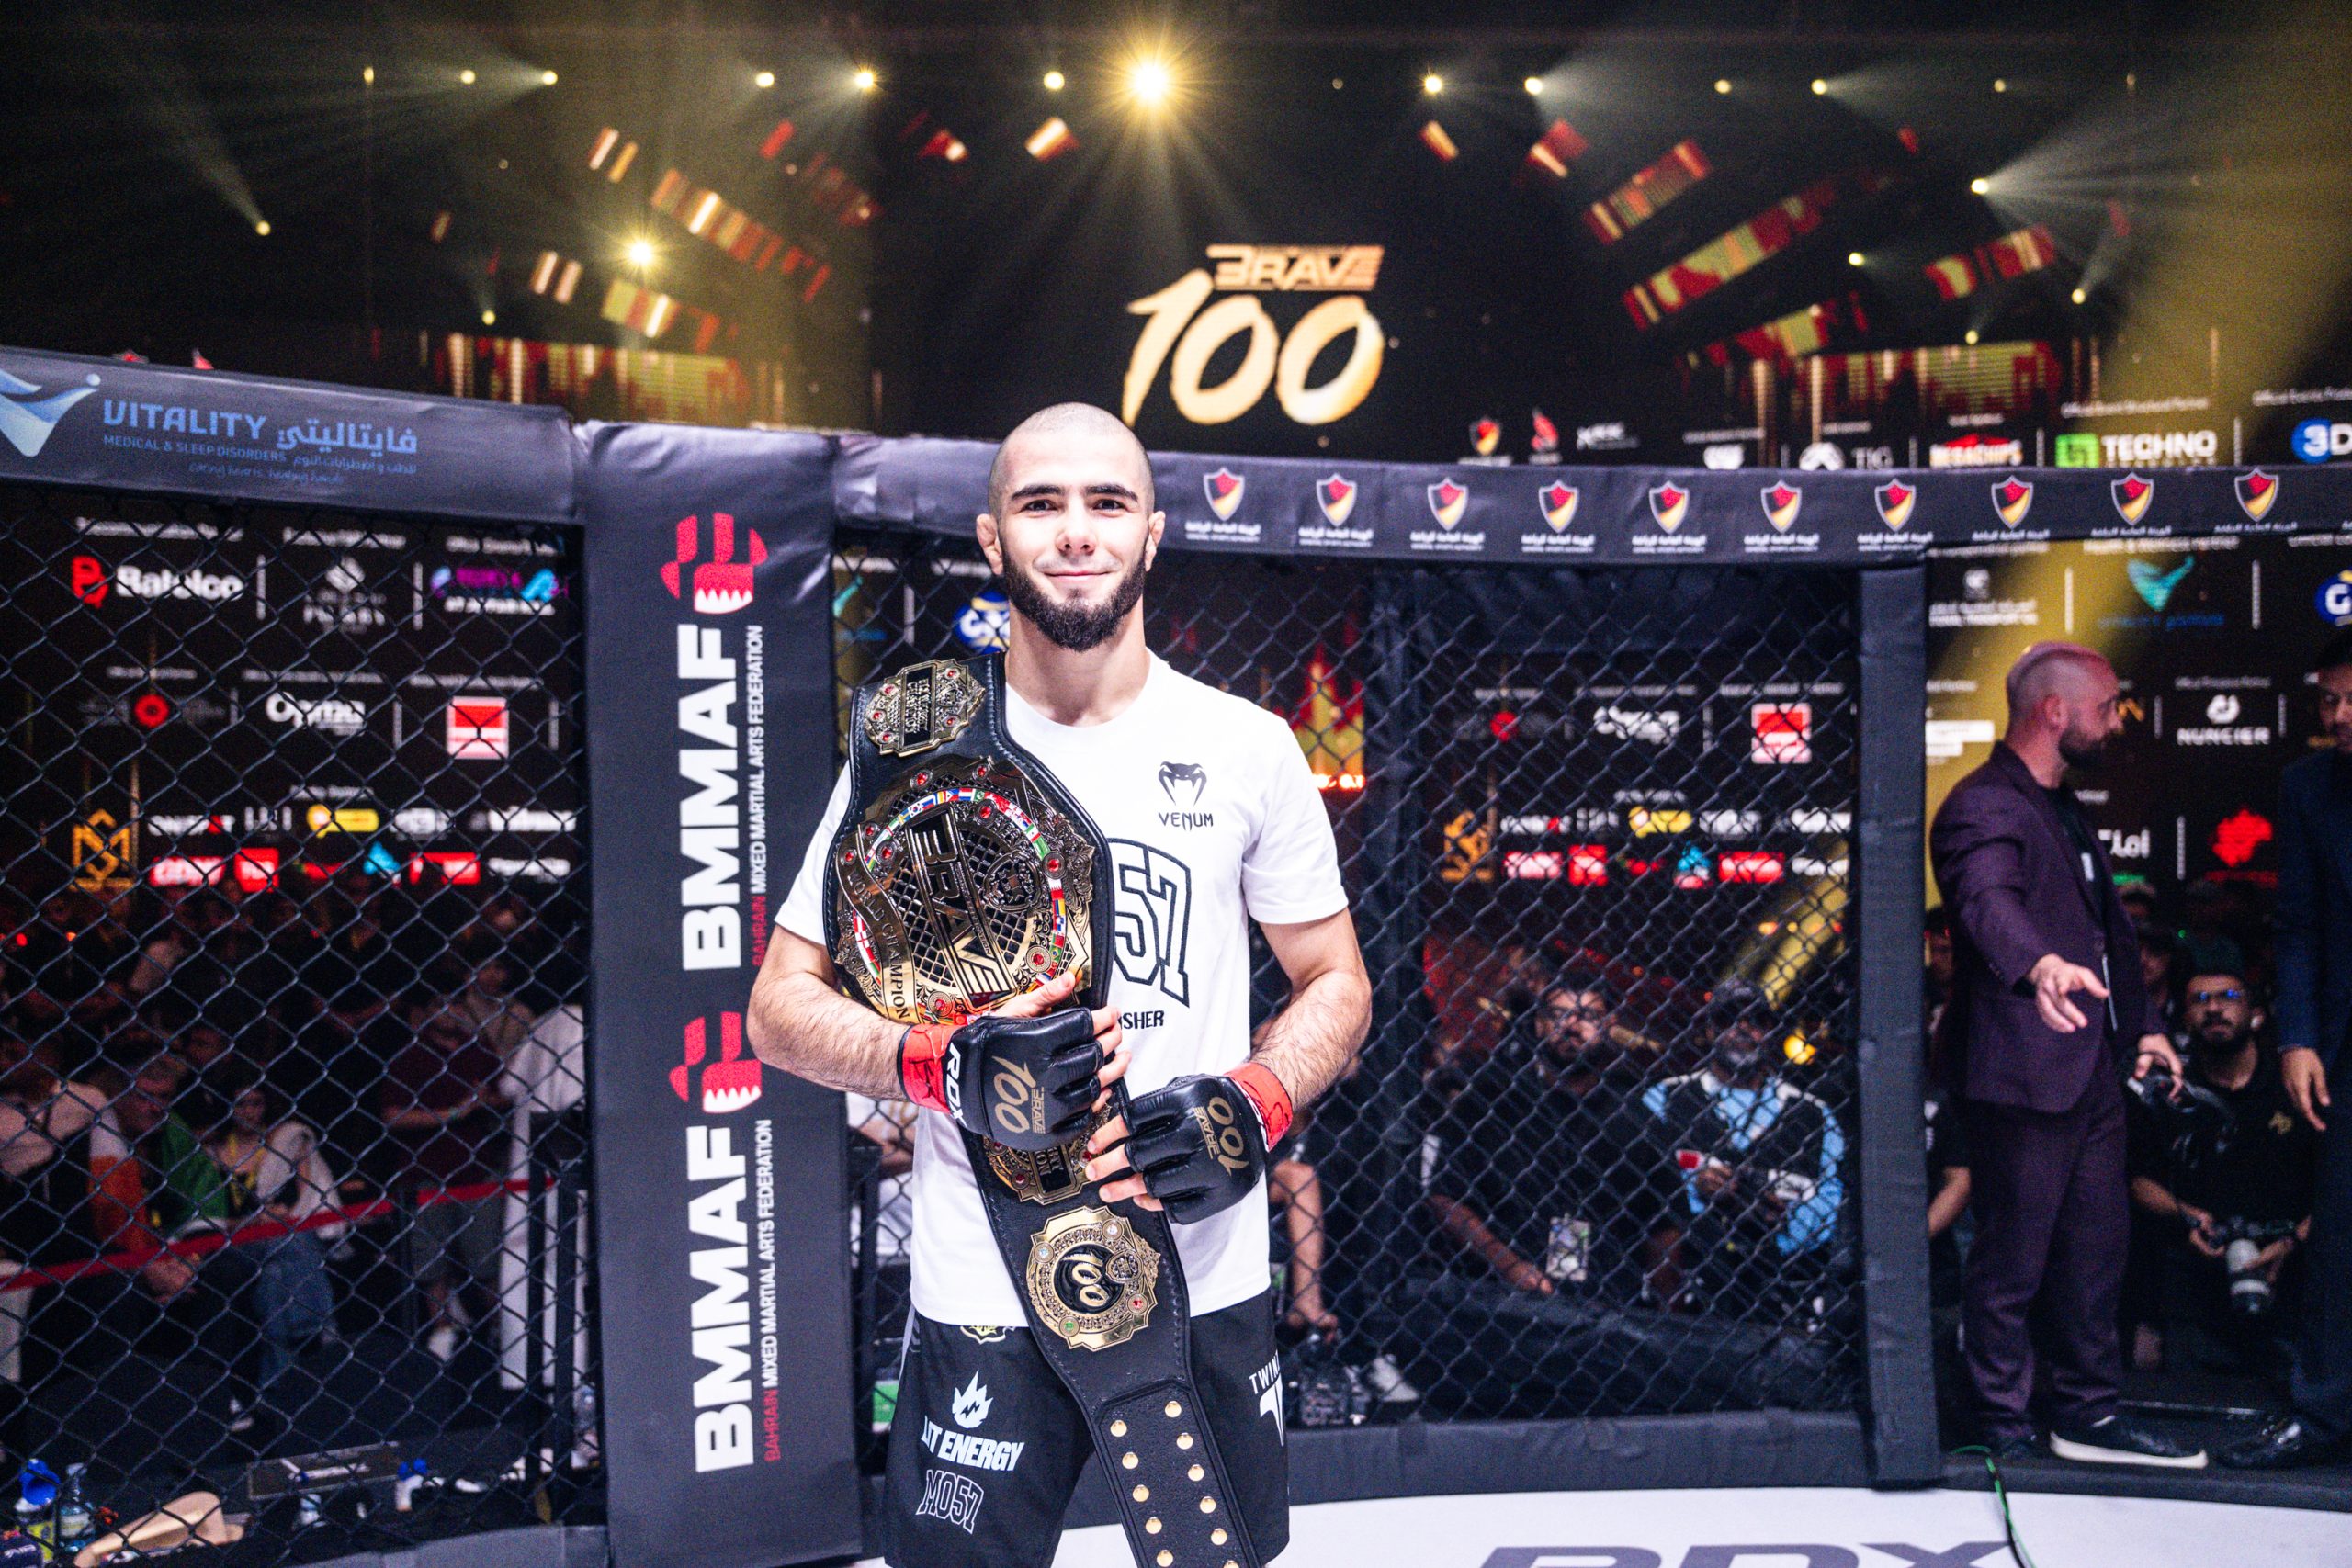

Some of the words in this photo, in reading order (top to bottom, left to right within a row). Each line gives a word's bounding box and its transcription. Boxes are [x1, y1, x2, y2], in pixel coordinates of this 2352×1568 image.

[1205, 243, 1385, 291] BRAVE
[1122, 267, 1385, 428] 100
[103, 399, 266, 440] VITALITY
[103, 434, 159, 451] MEDICAL
[164, 441, 173, 452] &
[176, 441, 215, 455] SLEEP
[217, 446, 287, 463] DISORDERS
[2102, 430, 2217, 461] TECHNO
[745, 625, 764, 725] FEDERATION
[746, 725, 765, 768] ARTS
[677, 624, 741, 970] BMMAF
[748, 768, 767, 840] MARTIAL
[1158, 811, 1214, 831] VENUM
[750, 840, 768, 894] MIXED
[847, 871, 886, 922] WORLD
[881, 922, 910, 1019] CHAMPION
[1107, 837, 1192, 1008] 57
[946, 1042, 967, 1128] RDX
[991, 1055, 1036, 1134] 100
[1031, 1087, 1046, 1134] BRAVE
[1193, 1106, 1221, 1160] BRAVE
[1207, 1096, 1250, 1176] 100
[754, 1119, 775, 1219] FEDERATION
[757, 1219, 775, 1262] ARTS
[686, 1125, 754, 1472] BMMAF
[758, 1262, 778, 1335] MARTIAL
[1061, 1247, 1110, 1307] 100
[761, 1335, 779, 1389] MIXED
[763, 1389, 781, 1462] BAHRAIN
[937, 1429, 1025, 1472] ENERGY
[915, 1469, 985, 1535] MO57
